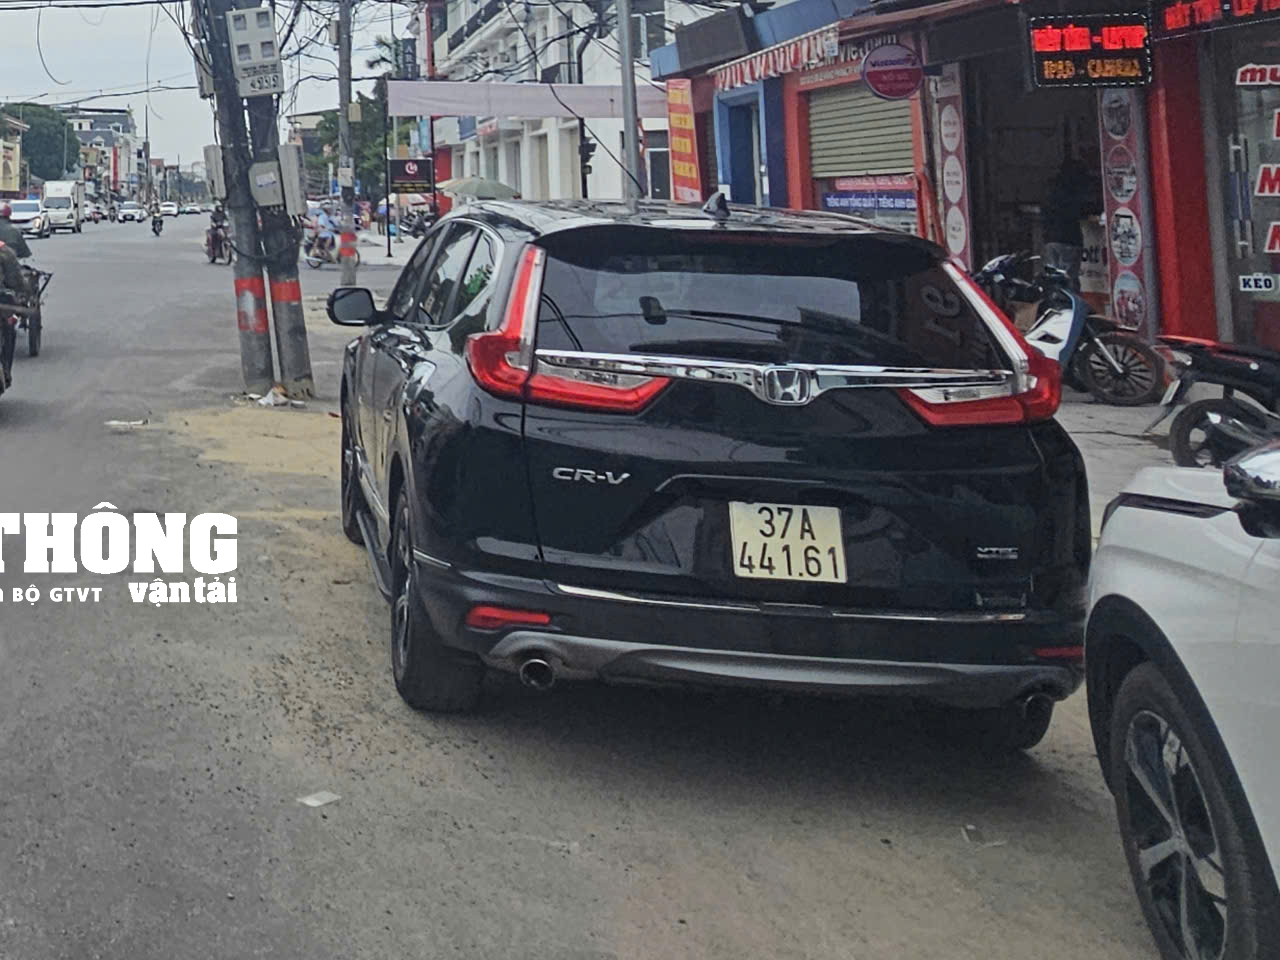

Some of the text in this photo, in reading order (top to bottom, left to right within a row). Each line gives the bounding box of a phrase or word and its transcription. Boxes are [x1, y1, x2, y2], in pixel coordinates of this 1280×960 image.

[552, 466, 631, 486] CR-V
[758, 506, 817, 541] 37A
[738, 541, 841, 581] 441.61
